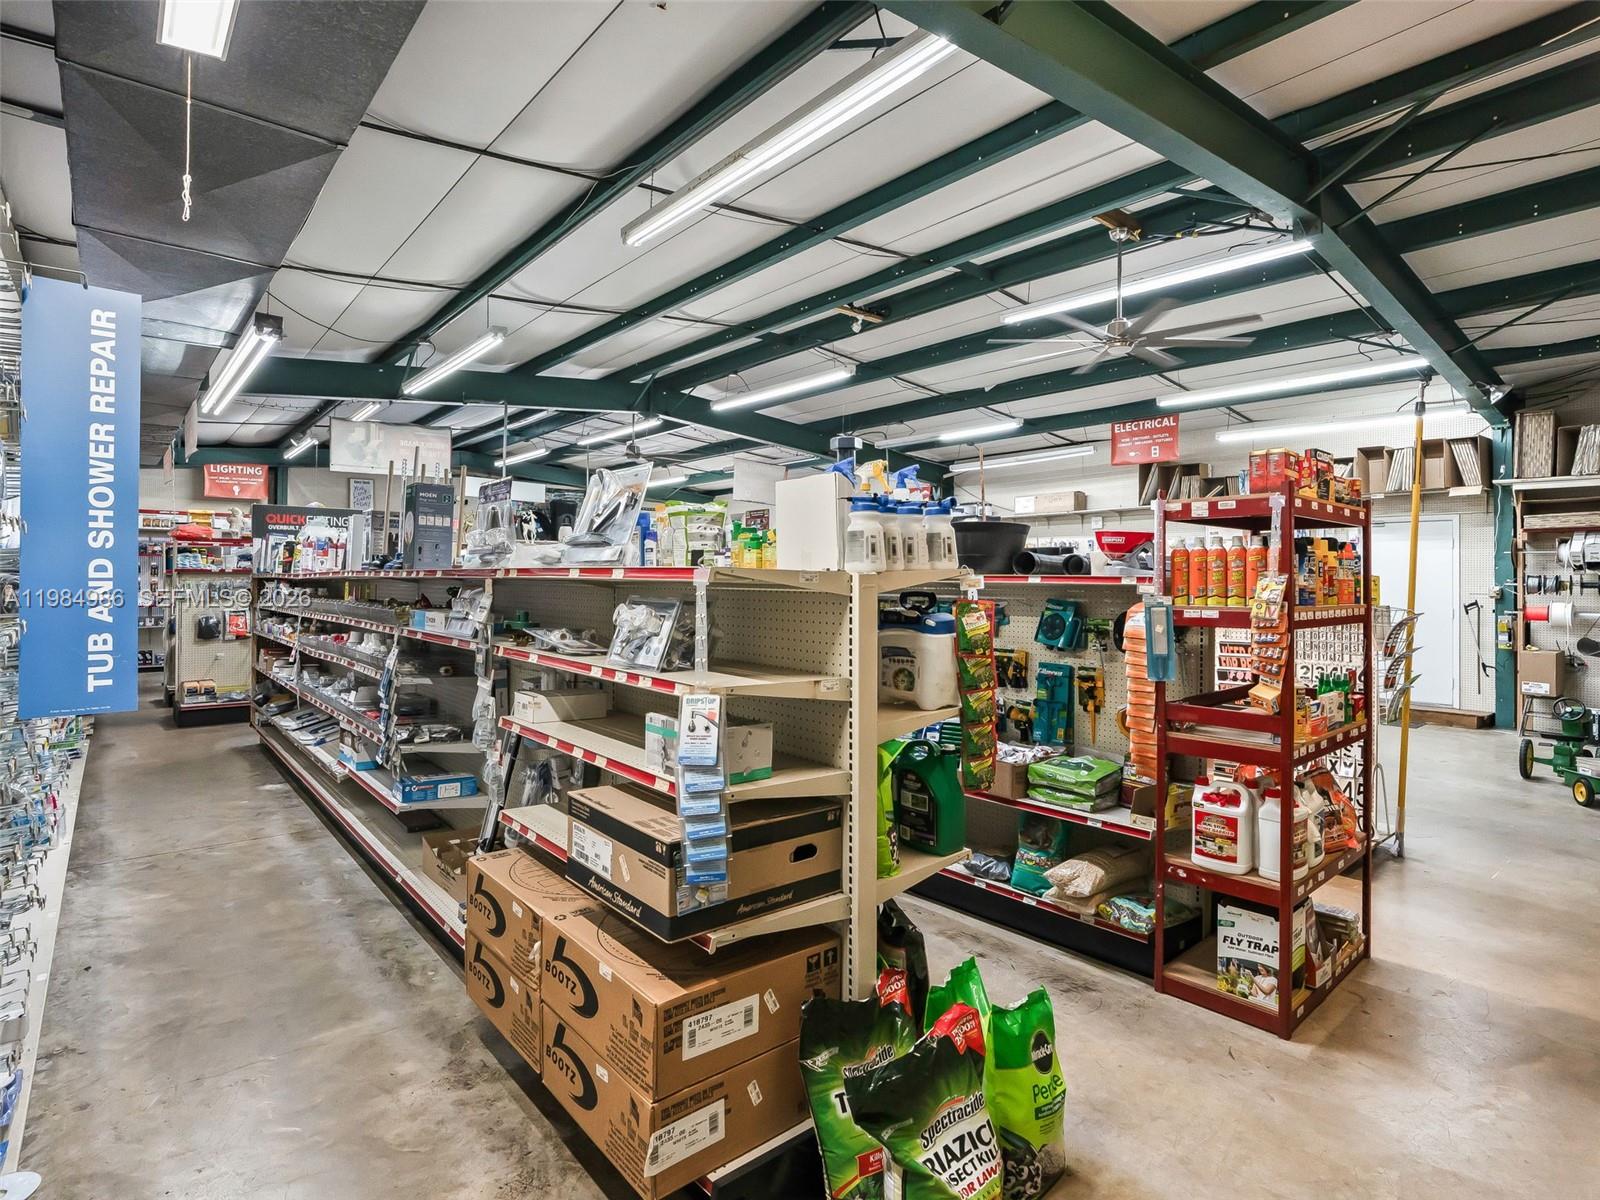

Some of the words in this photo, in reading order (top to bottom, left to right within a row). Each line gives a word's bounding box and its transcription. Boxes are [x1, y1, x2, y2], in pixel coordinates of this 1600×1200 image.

[90, 309, 117, 415] REPAIR
[1114, 416, 1176, 433] ELECTRICAL
[88, 423, 116, 549] SHOWER
[210, 464, 262, 476] LIGHTING
[265, 513, 349, 528] QUICKFTING
[88, 558, 115, 618] AND
[88, 632, 114, 692] TUB
[469, 894, 492, 921] BOOTZ
[587, 875, 613, 901] American
[611, 891, 642, 918] Standard
[1222, 935, 1244, 947] FLY
[1246, 940, 1279, 955] TRAP
[468, 961, 491, 991] BOOTZ
[545, 959, 577, 995] BOOTZ
[687, 1014, 713, 1029] 418797
[545, 1046, 577, 1085] BOOTZ
[655, 1126, 676, 1143] 18797
[920, 1091, 985, 1149] Spectracide
[921, 1118, 996, 1177] RIAZICI
